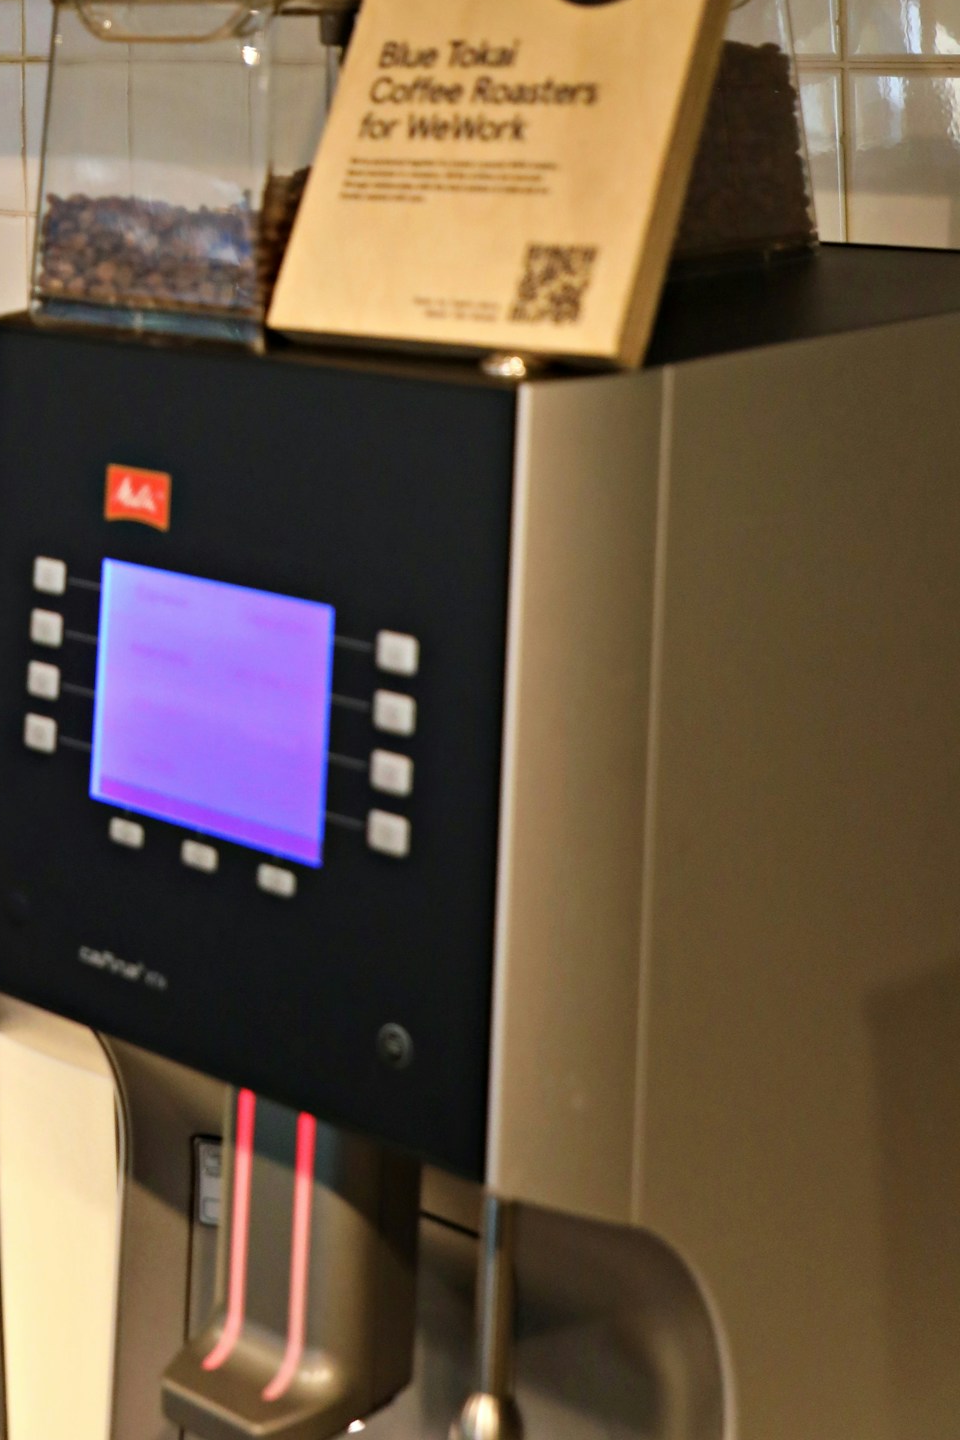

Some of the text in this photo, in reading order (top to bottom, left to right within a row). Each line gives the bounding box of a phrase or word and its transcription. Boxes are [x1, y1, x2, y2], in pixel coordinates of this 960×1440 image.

[378, 39, 520, 68] Blue Tokai
[370, 75, 600, 106] Coffee Roasters
[358, 111, 527, 141] for WeWork
